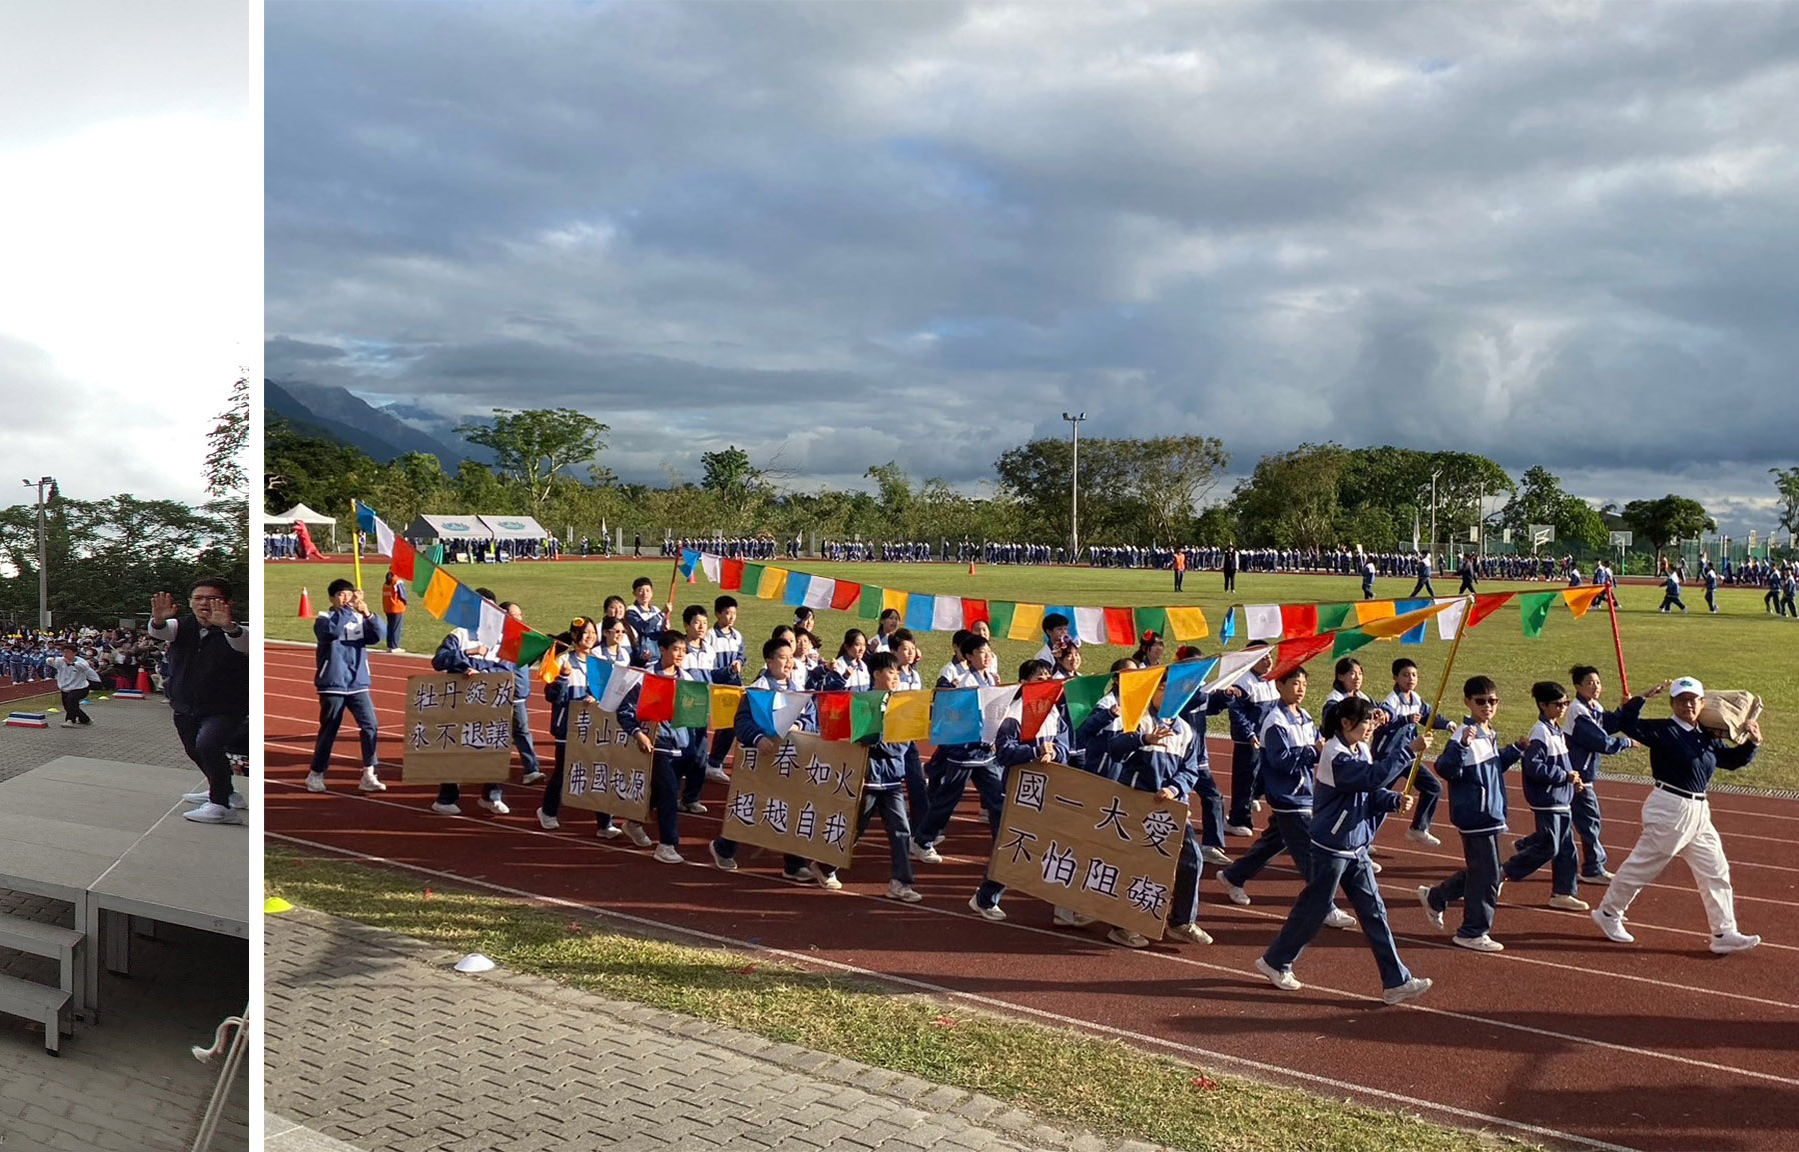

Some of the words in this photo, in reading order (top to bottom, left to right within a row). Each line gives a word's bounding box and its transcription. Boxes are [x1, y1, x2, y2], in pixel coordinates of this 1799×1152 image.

[414, 679, 513, 712] 牡丹綻放
[410, 719, 509, 750] 永不退讓
[575, 709, 650, 747] 青山
[568, 762, 645, 802] 佛國起源
[727, 790, 848, 852] 超越自我
[1016, 770, 1179, 858] 國一大愛
[1002, 828, 1168, 920] 不怕阻礙
